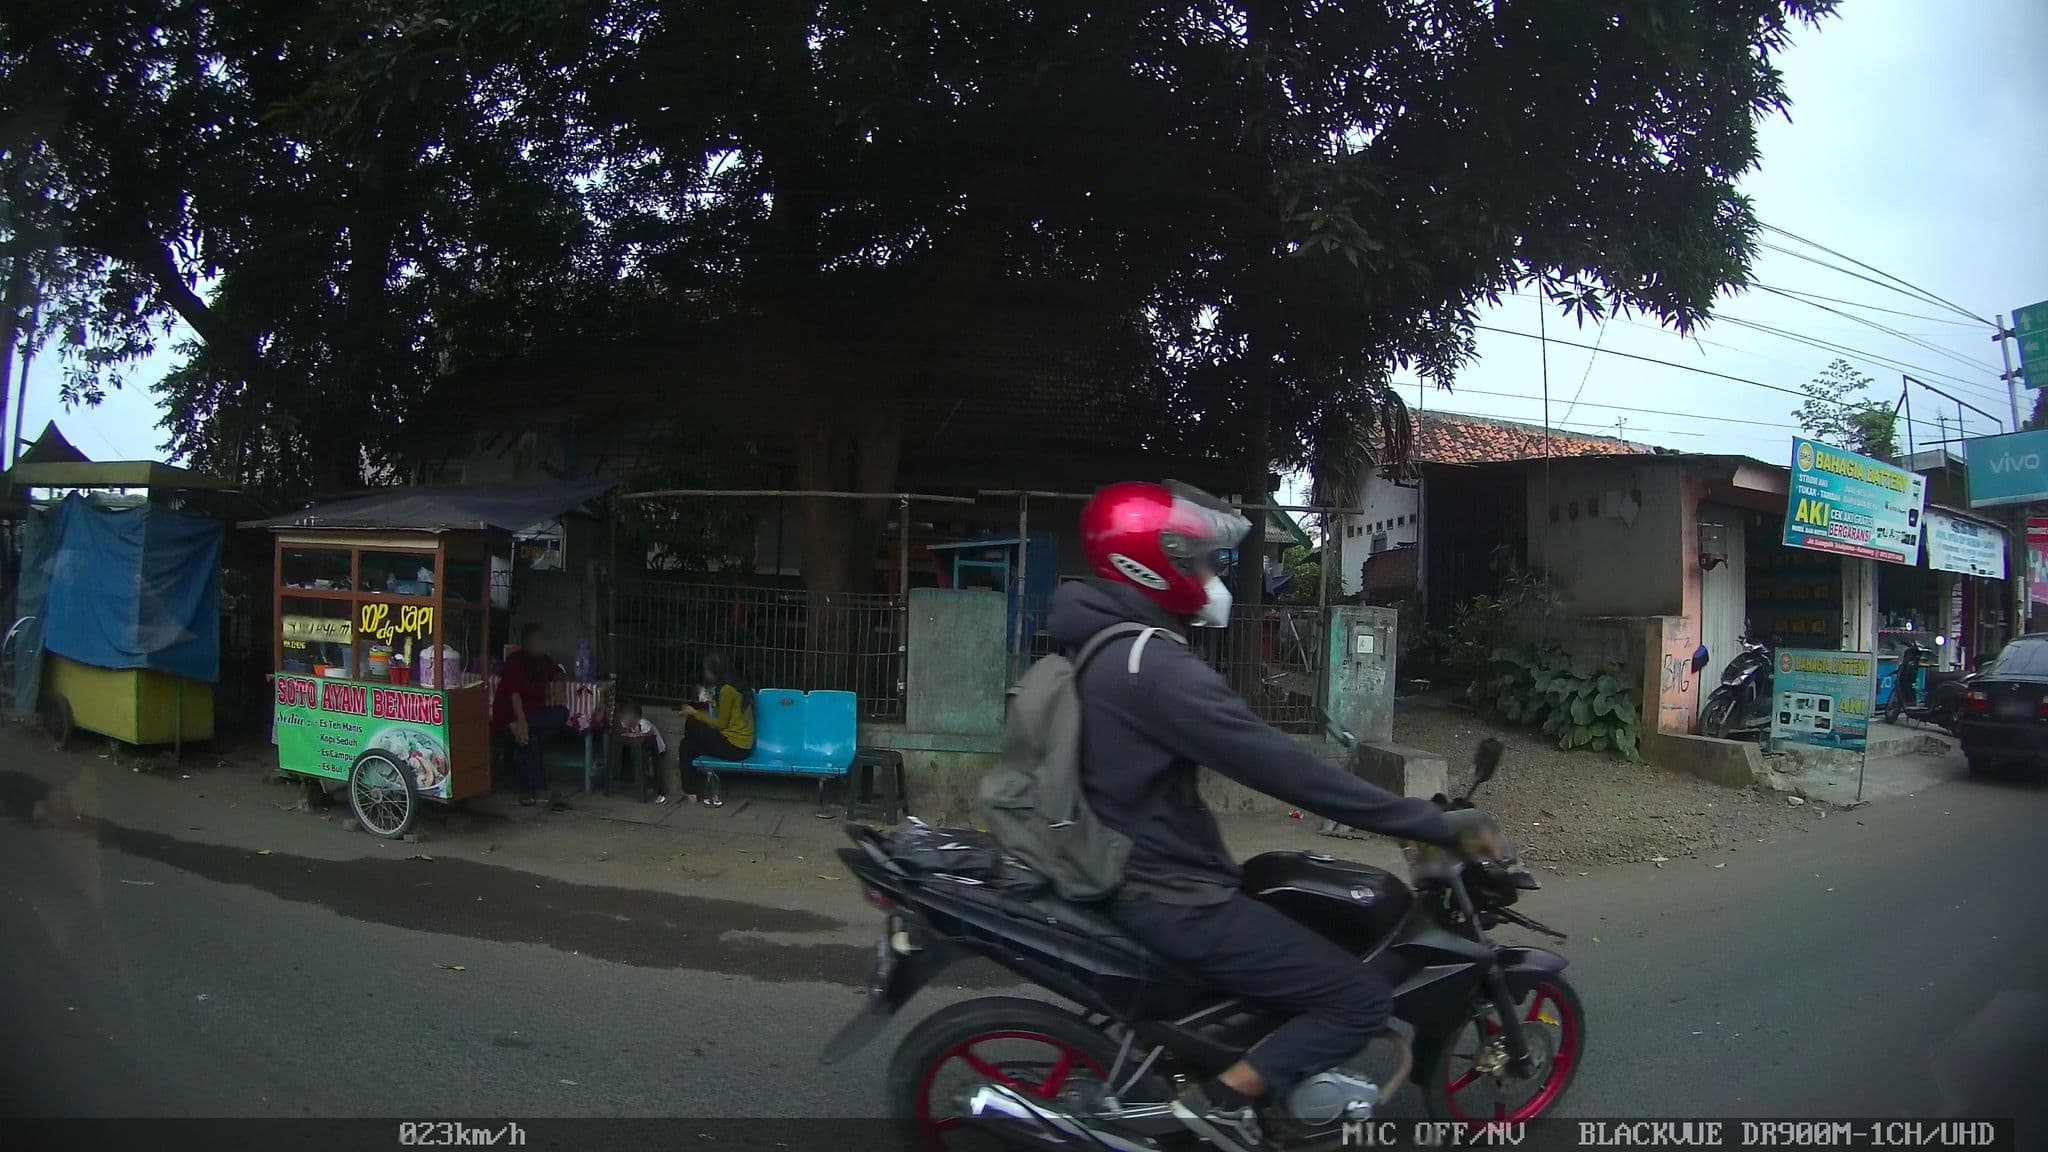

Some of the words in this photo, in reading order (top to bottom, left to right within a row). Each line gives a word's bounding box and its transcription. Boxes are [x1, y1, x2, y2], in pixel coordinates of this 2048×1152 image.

[1990, 452, 2040, 474] vivo
[1795, 497, 1831, 527] AKI
[277, 677, 317, 709] SOTO
[322, 682, 367, 716] AYAM
[372, 688, 443, 725] BENING
